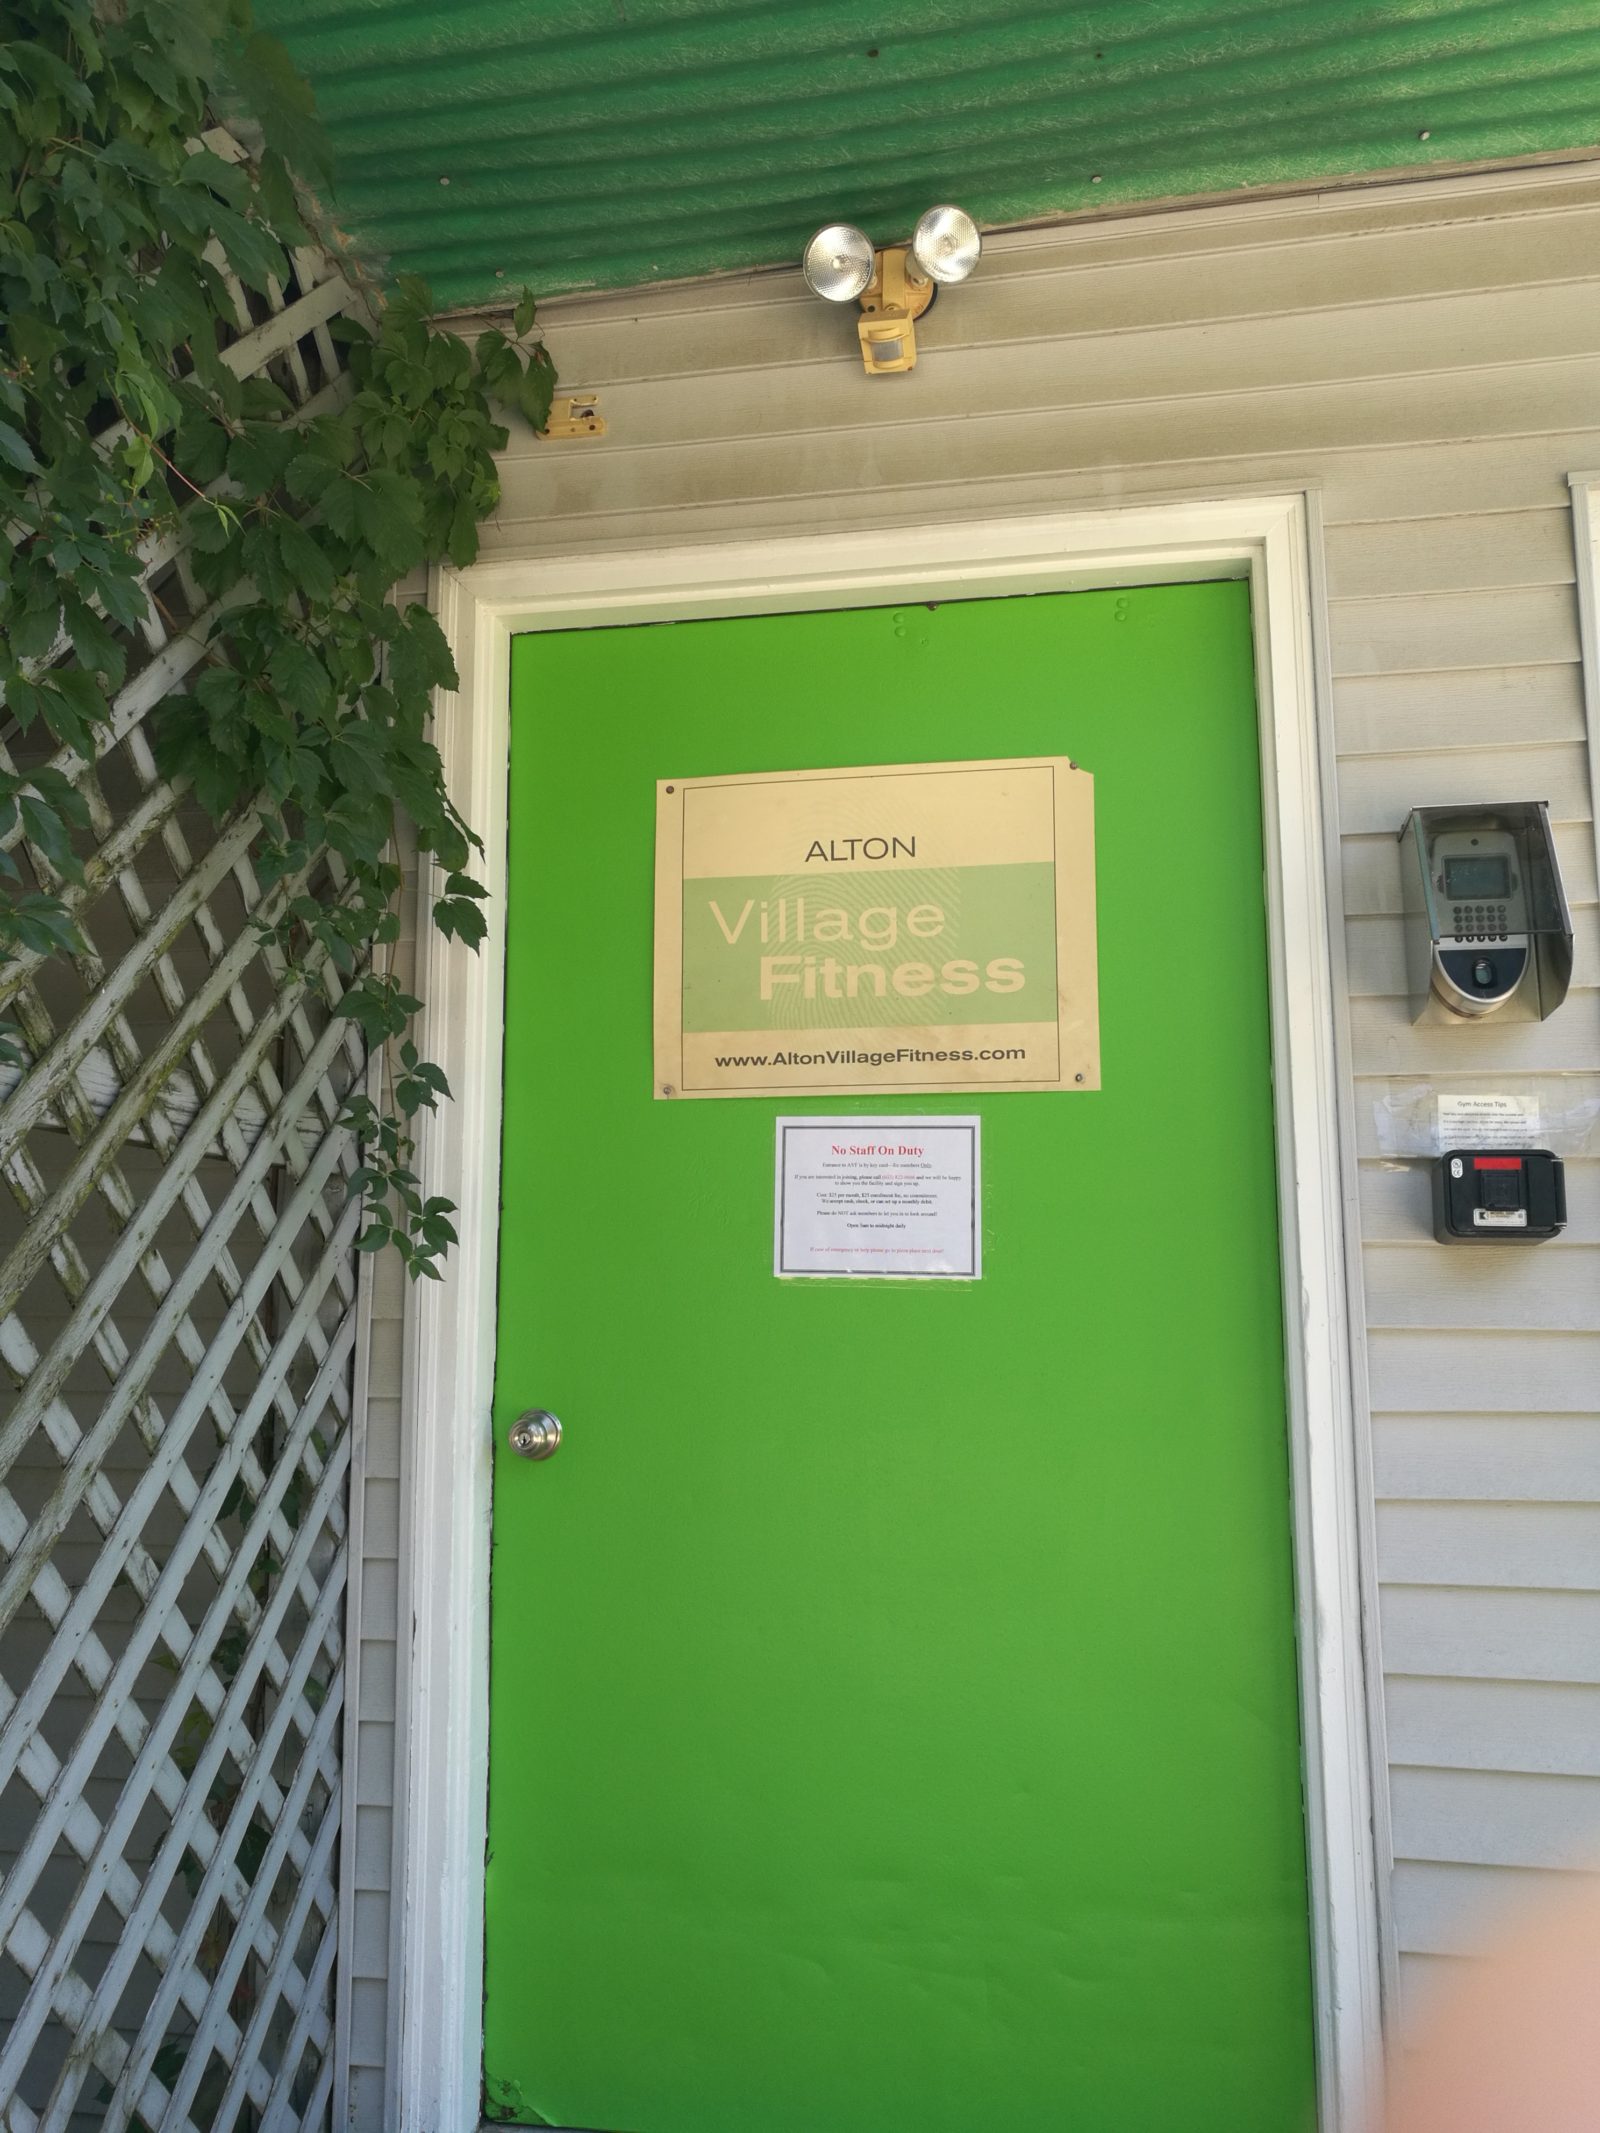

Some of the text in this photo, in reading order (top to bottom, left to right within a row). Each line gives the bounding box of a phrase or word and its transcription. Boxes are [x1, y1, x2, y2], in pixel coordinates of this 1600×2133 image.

[804, 836, 916, 863] ALTON
[708, 897, 946, 952] Village
[759, 954, 1026, 1001] Fitness
[715, 1047, 1026, 1068] www.AltonVillageFitness.com
[832, 1145, 924, 1157] No Staff On Duty
